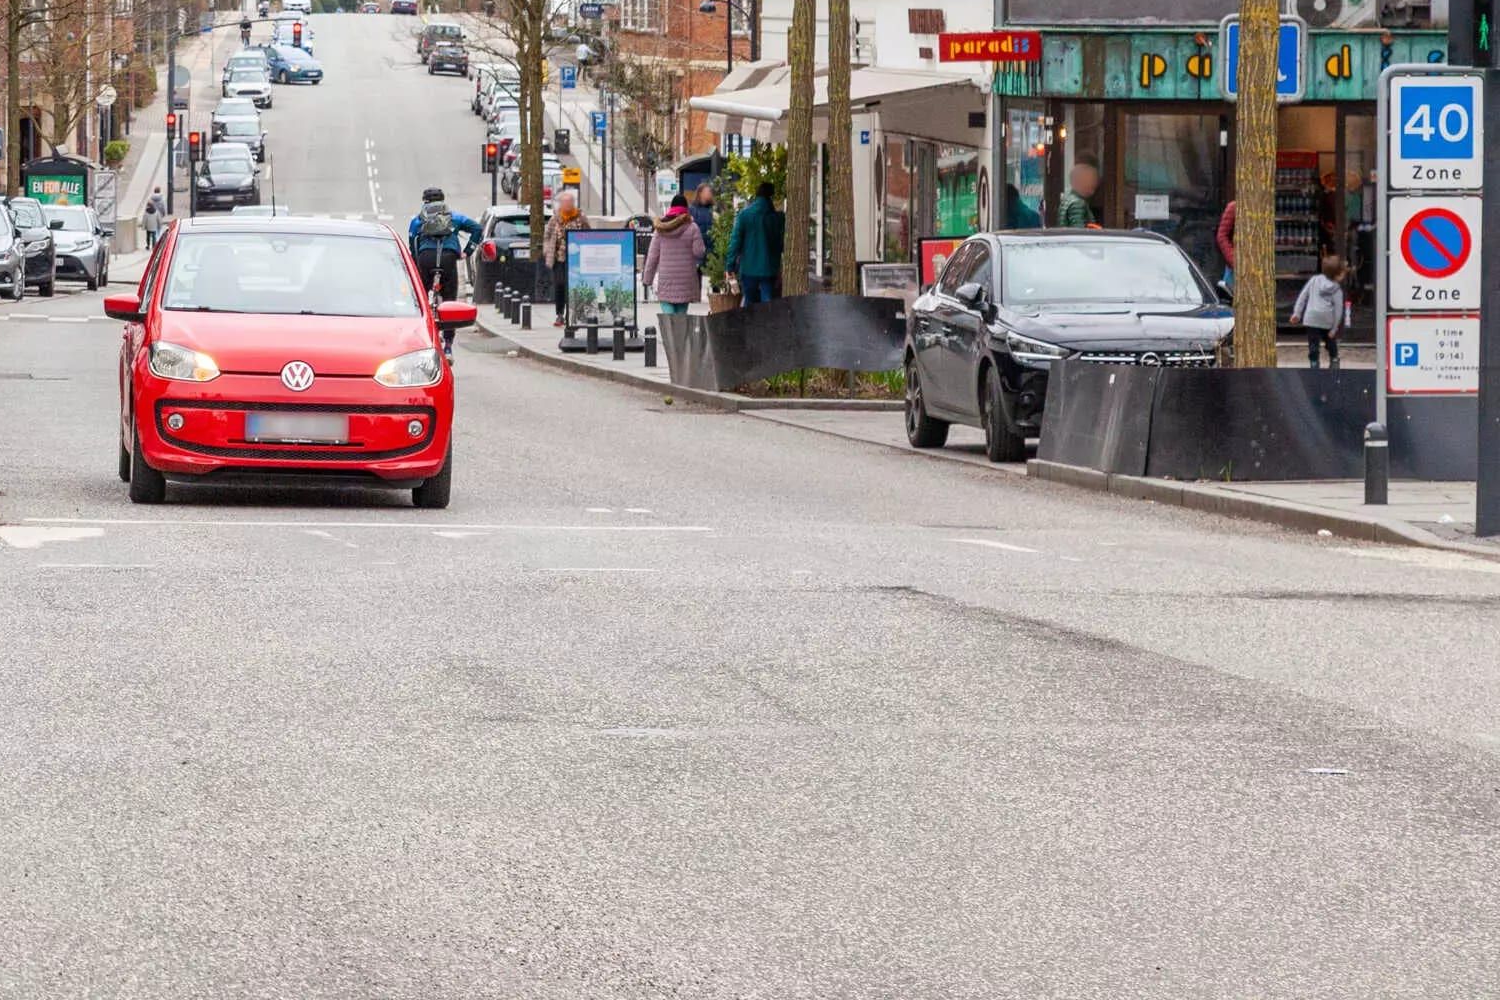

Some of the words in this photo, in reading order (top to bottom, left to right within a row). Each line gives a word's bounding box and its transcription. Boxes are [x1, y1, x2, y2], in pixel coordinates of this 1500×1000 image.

[949, 35, 1030, 60] paradis
[1403, 103, 1469, 142] 40
[1412, 165, 1462, 180] Zone
[32, 181, 44, 193] EN
[44, 181, 61, 194] FOR
[61, 181, 81, 194] ALLE
[1411, 286, 1461, 300] Zone
[1443, 329, 1464, 337] time
[1438, 341, 1460, 349] 9-18
[1401, 345, 1414, 364] P
[1435, 352, 1465, 361] (9-14)
